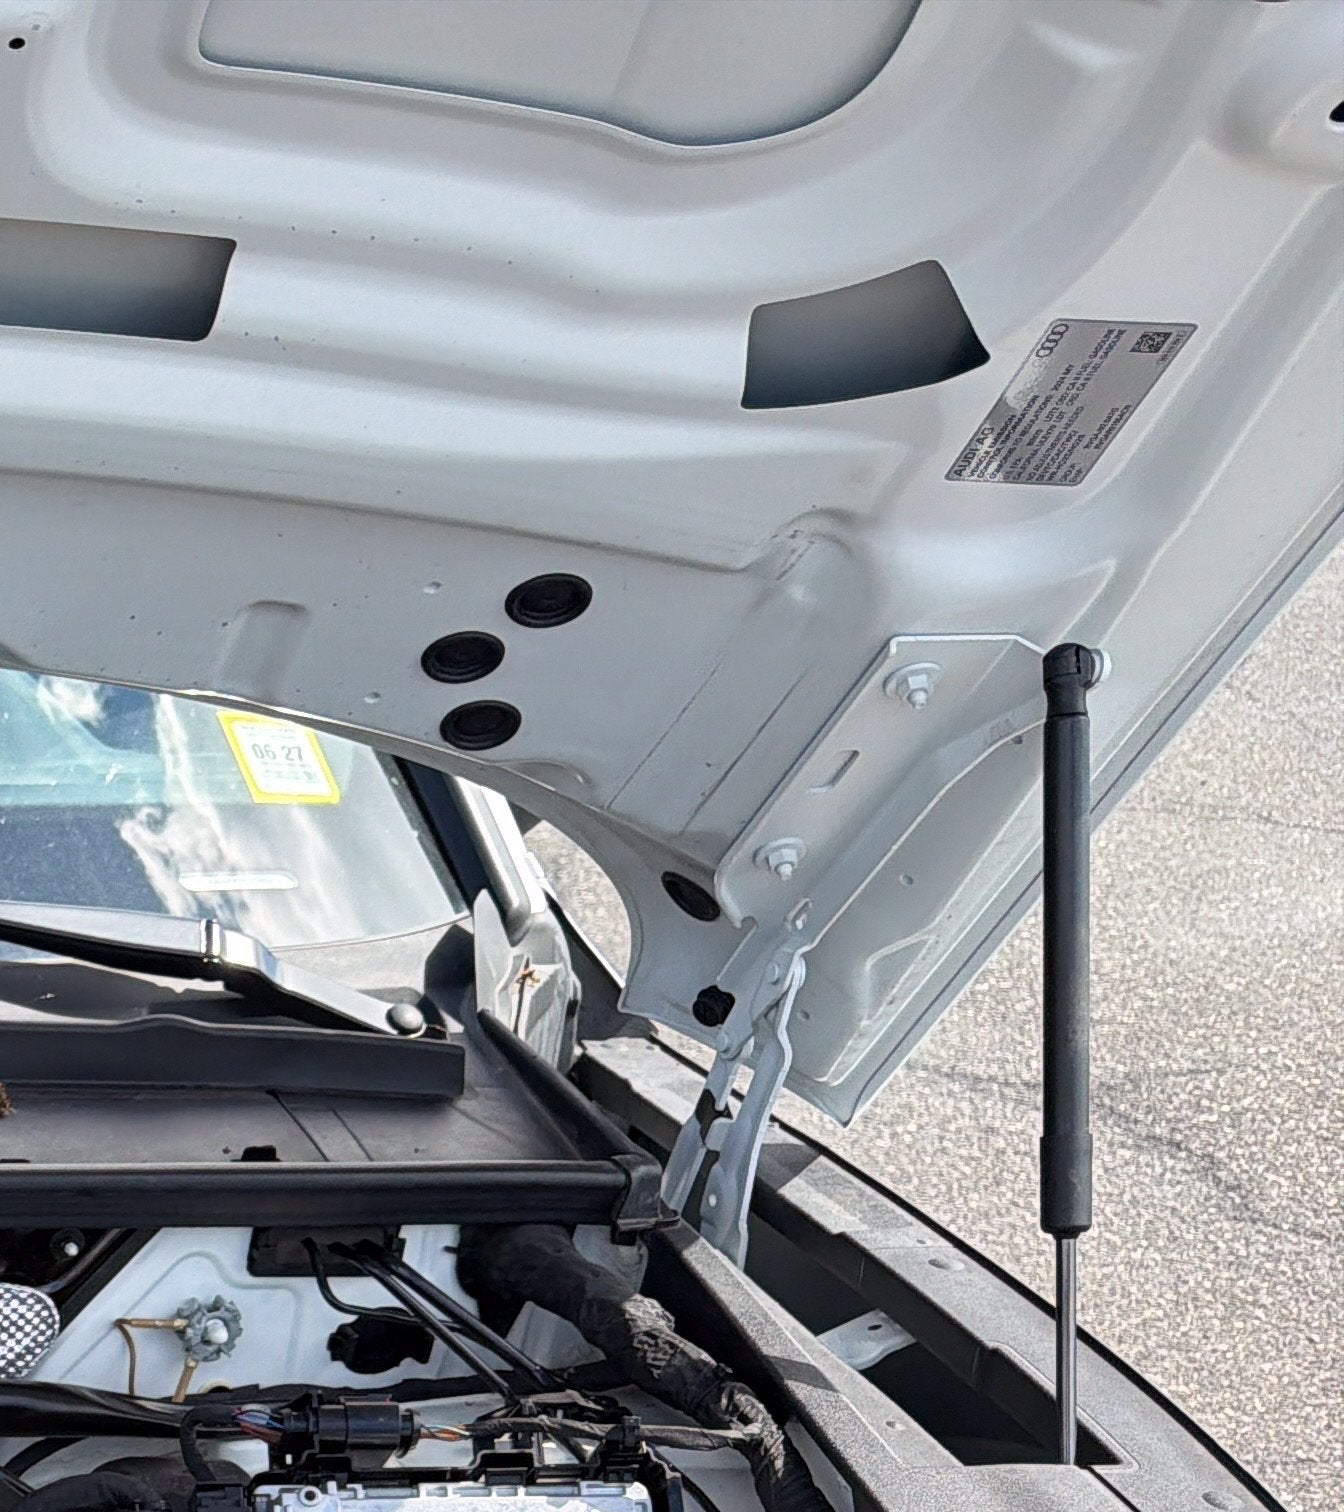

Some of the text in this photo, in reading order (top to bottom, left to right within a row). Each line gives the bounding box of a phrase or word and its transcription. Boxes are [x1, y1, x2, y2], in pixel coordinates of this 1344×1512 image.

[952, 447, 980, 477] AUDI
[252, 743, 303, 761] 06 27
